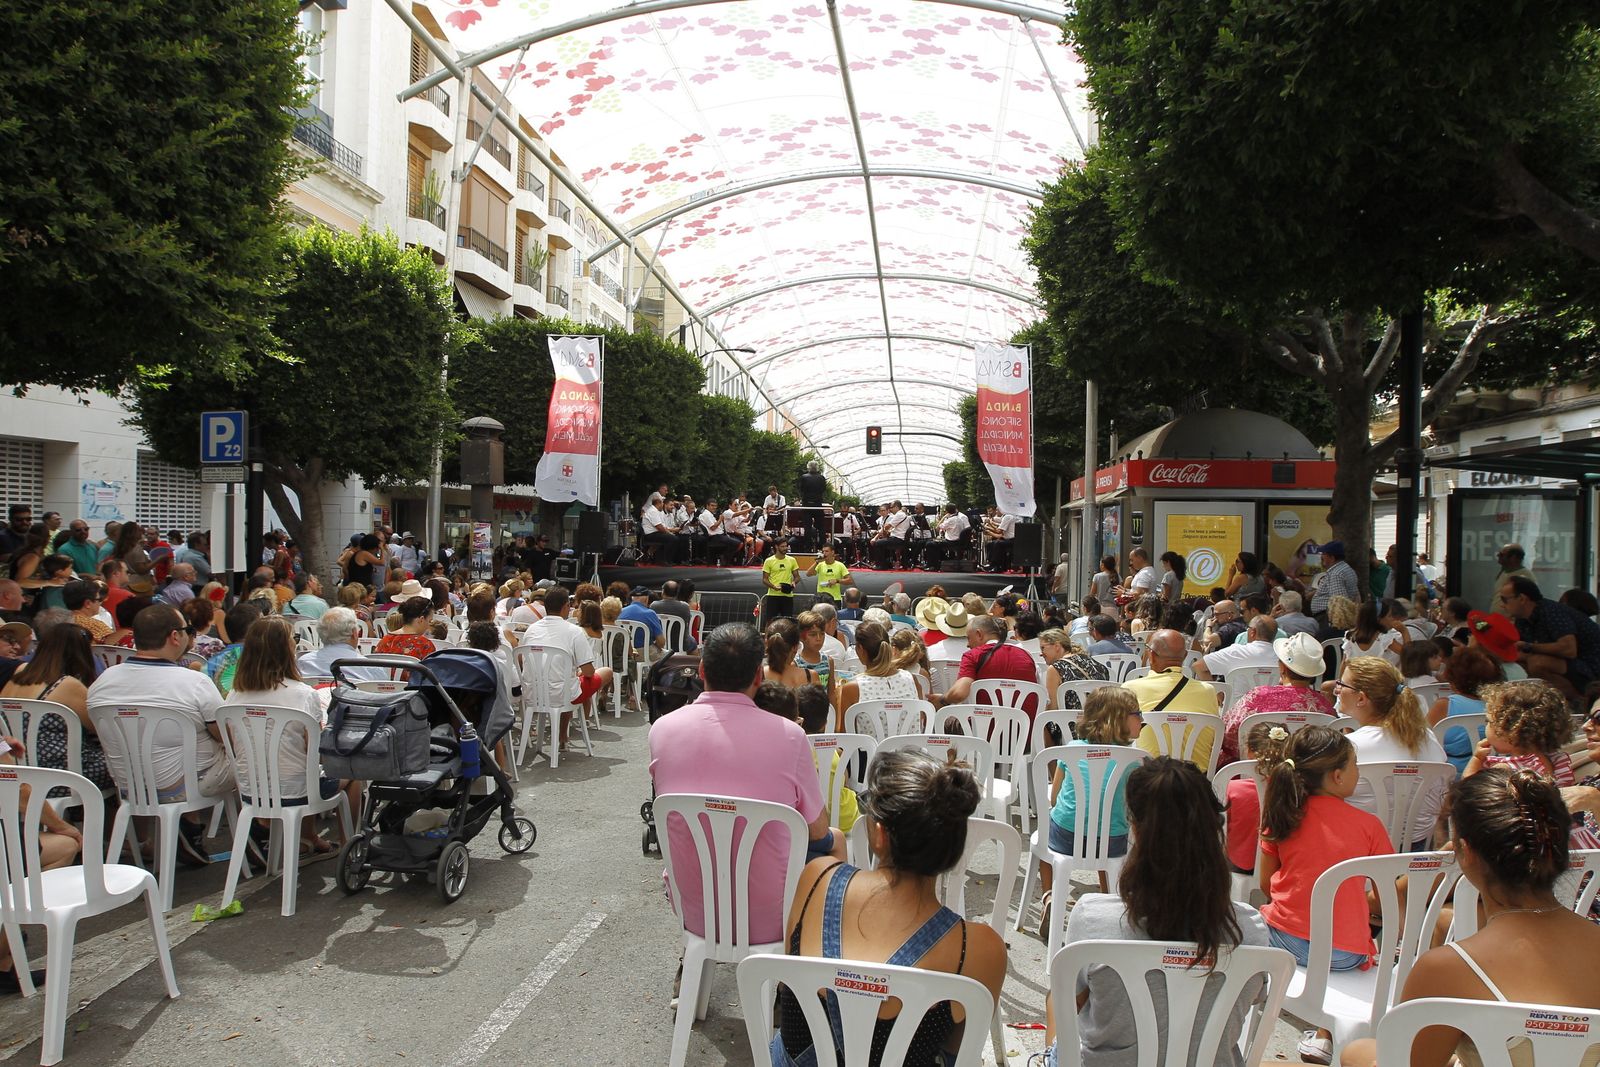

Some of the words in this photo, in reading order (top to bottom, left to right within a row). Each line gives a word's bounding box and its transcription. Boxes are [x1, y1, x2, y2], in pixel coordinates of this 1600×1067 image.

[209, 416, 235, 457] P
[224, 444, 241, 457] Z2
[1149, 464, 1211, 484] Coca-Cola
[837, 971, 861, 979] RENTA
[863, 975, 886, 983] TODO
